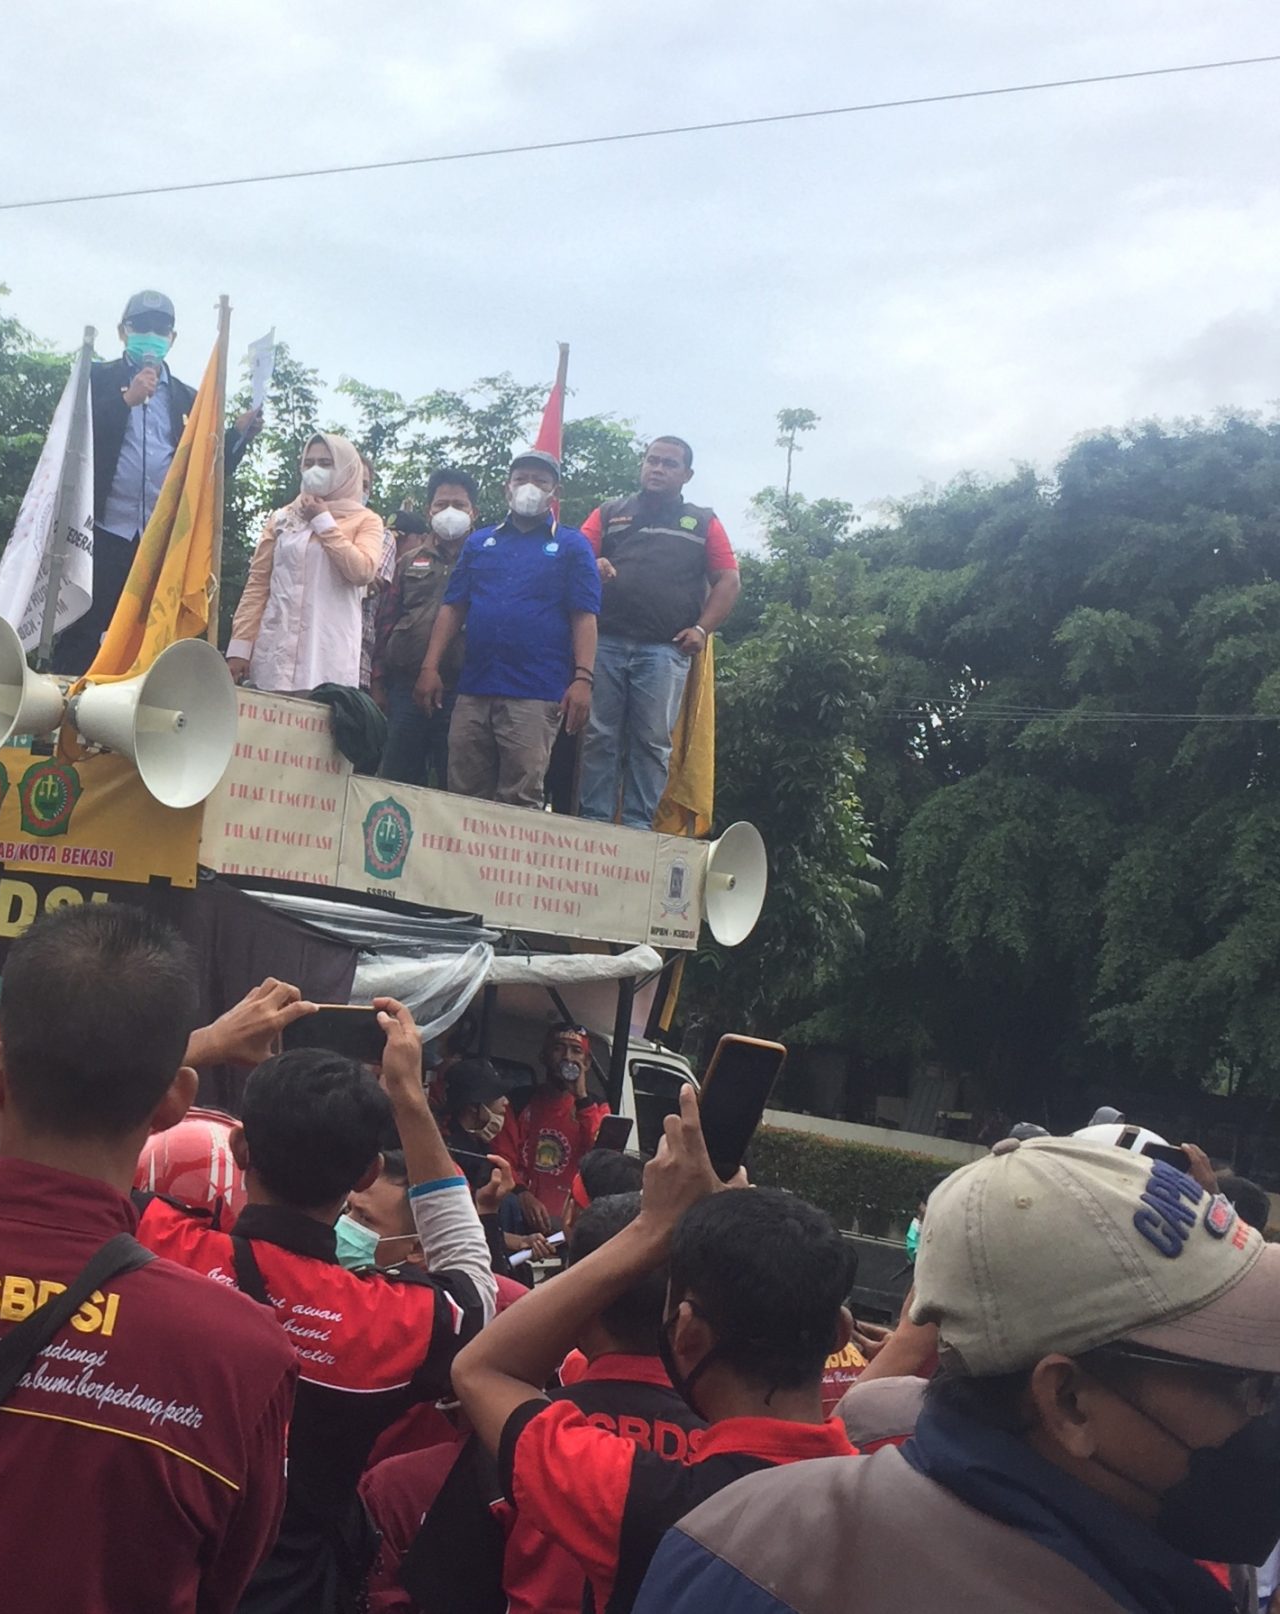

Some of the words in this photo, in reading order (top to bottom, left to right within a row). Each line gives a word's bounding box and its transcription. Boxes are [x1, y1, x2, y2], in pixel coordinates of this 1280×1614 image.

[230, 782, 265, 801] PILAR
[224, 822, 261, 841] PILAR
[462, 816, 508, 840] DEWAN
[421, 832, 487, 858] FEDERASI
[61, 846, 114, 868] BEKASI
[291, 1303, 343, 1322] awan
[282, 1317, 333, 1341] bumi
[32, 1361, 78, 1395] bumi
[159, 1399, 204, 1429] petir
